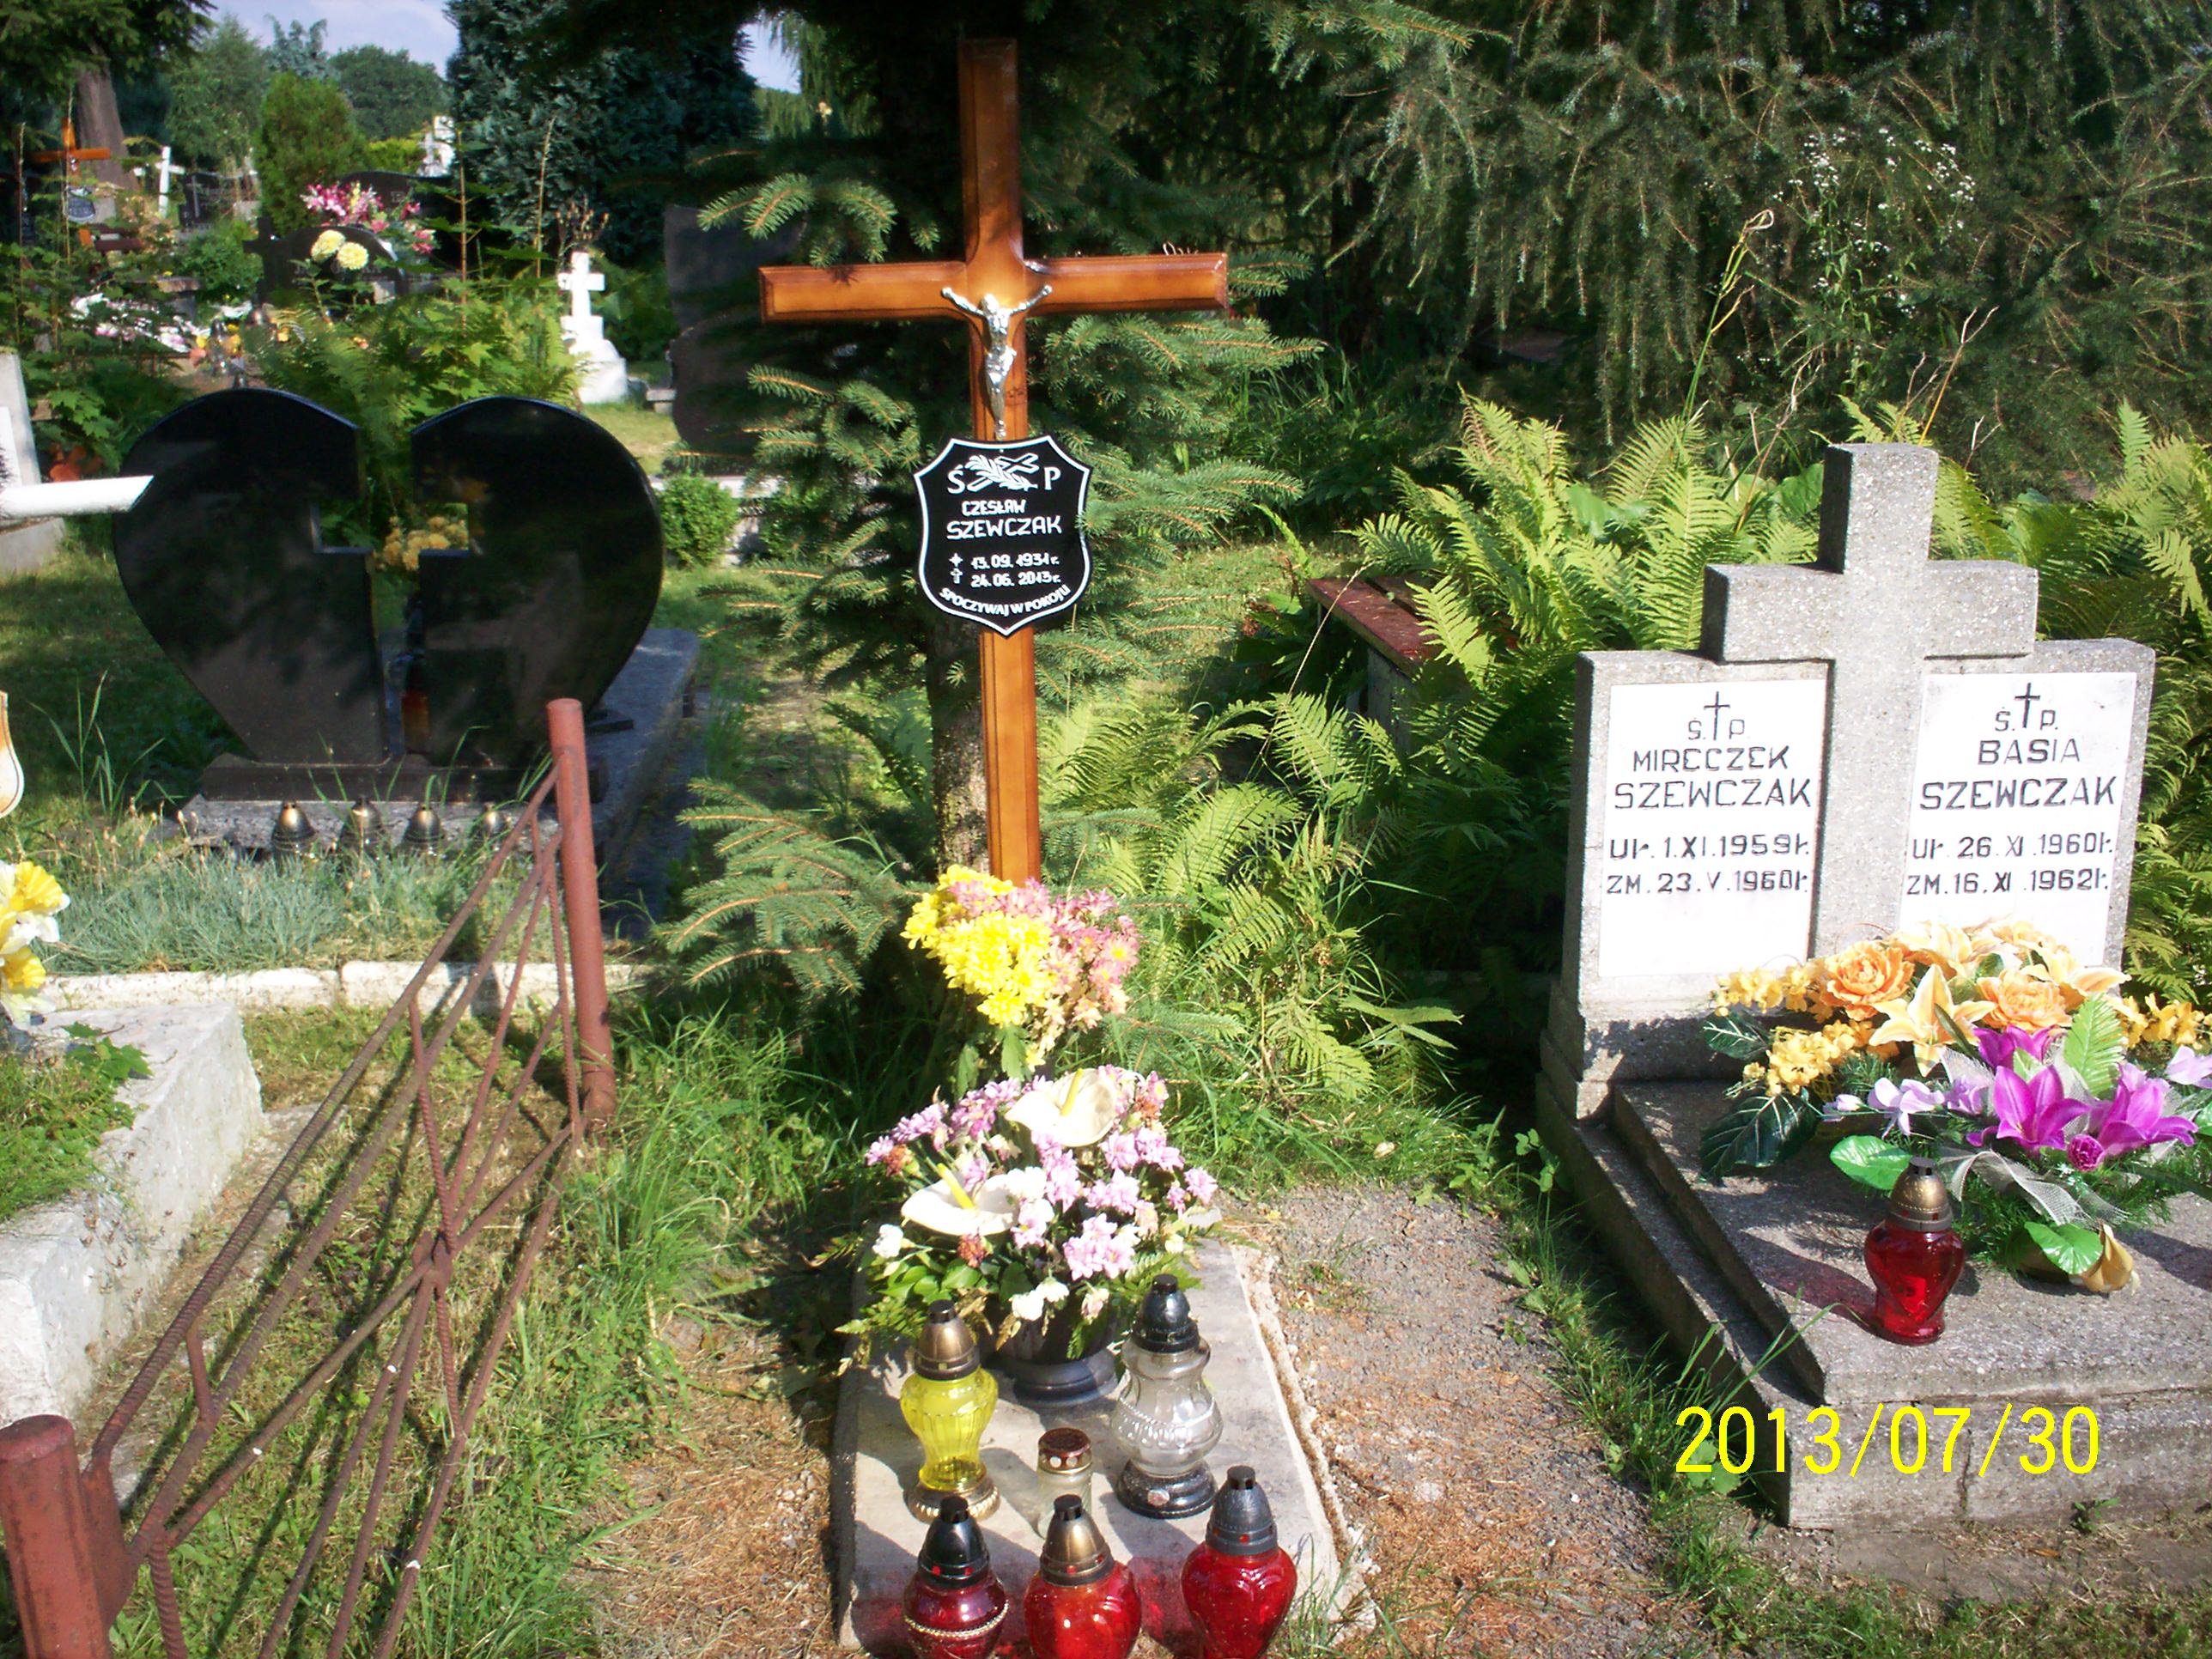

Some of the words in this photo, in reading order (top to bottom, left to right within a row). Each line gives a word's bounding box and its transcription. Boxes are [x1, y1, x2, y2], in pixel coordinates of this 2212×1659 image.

[1044, 466, 1061, 490] P
[962, 499, 1026, 516] CZESŁAW
[946, 515, 1062, 540] SZEWCZAK
[939, 587, 1010, 617] SPOCZYWAJ
[1010, 603, 1024, 614] W
[1024, 584, 1071, 612] POKOJU
[1632, 745, 1790, 773] MIRECZEK
[1978, 738, 2081, 766] BASIA
[1614, 778, 1812, 810] SZEWCZAK
[1919, 776, 2117, 811] SZEWCZAK
